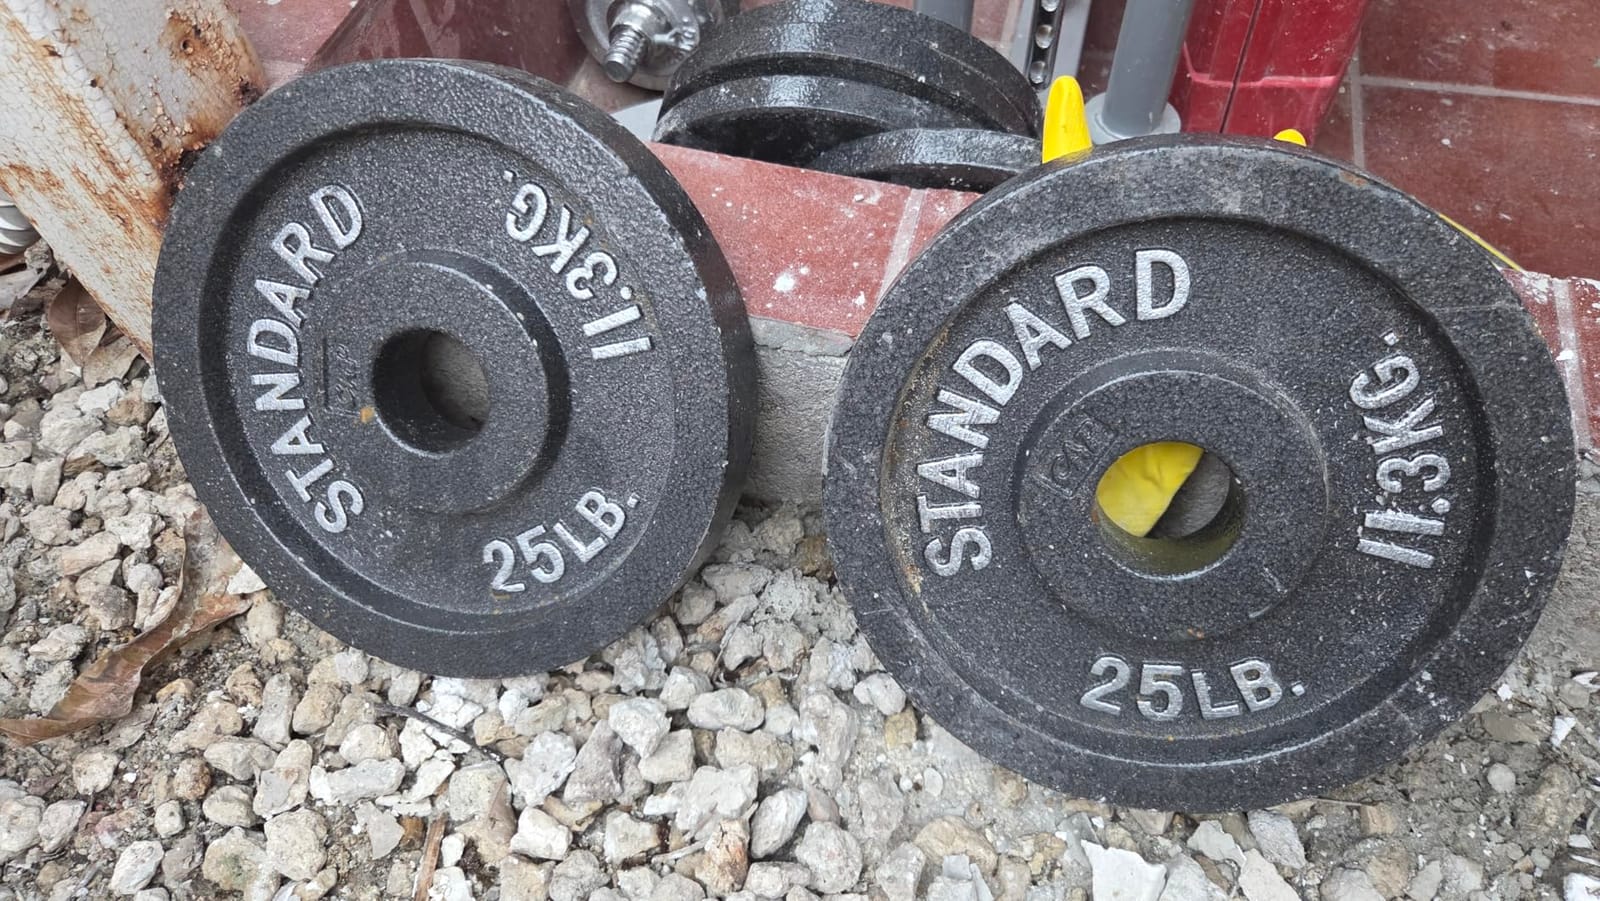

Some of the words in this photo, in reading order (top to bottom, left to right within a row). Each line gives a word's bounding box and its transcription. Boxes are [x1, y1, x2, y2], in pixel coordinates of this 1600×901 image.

[246, 184, 366, 535] STANDARD
[503, 170, 652, 360] 11.3KG.
[916, 249, 1192, 578] STANDARD
[1349, 329, 1452, 568] 11.3KG.
[482, 489, 639, 593] 25LB.
[1079, 656, 1305, 721] 25LB.
